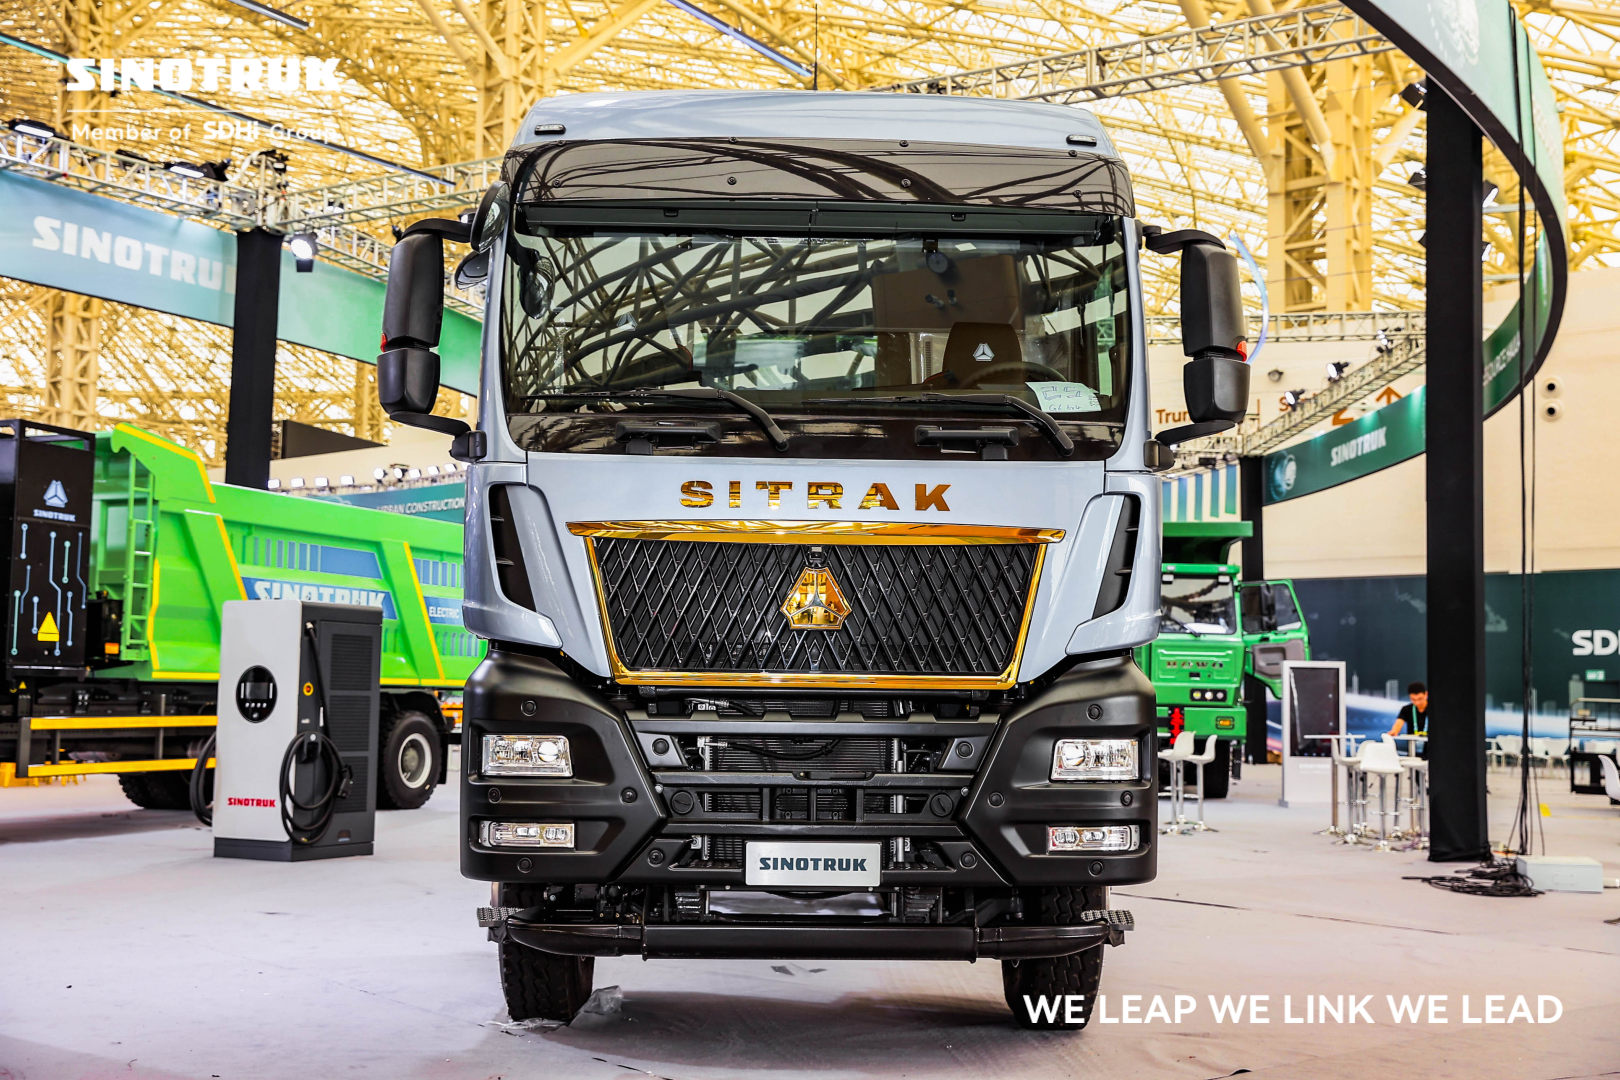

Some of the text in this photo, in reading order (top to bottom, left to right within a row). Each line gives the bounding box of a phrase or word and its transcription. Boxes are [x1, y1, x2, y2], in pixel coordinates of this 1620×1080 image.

[1330, 426, 1387, 467] SINOTRUK
[679, 480, 951, 511] SITRAK
[33, 508, 76, 522] SINOTRUK
[428, 606, 460, 619] ELECTRIC
[1571, 629, 1620, 656] SD
[227, 797, 276, 807] SINOTRUK
[759, 857, 867, 871] SINOTRUK
